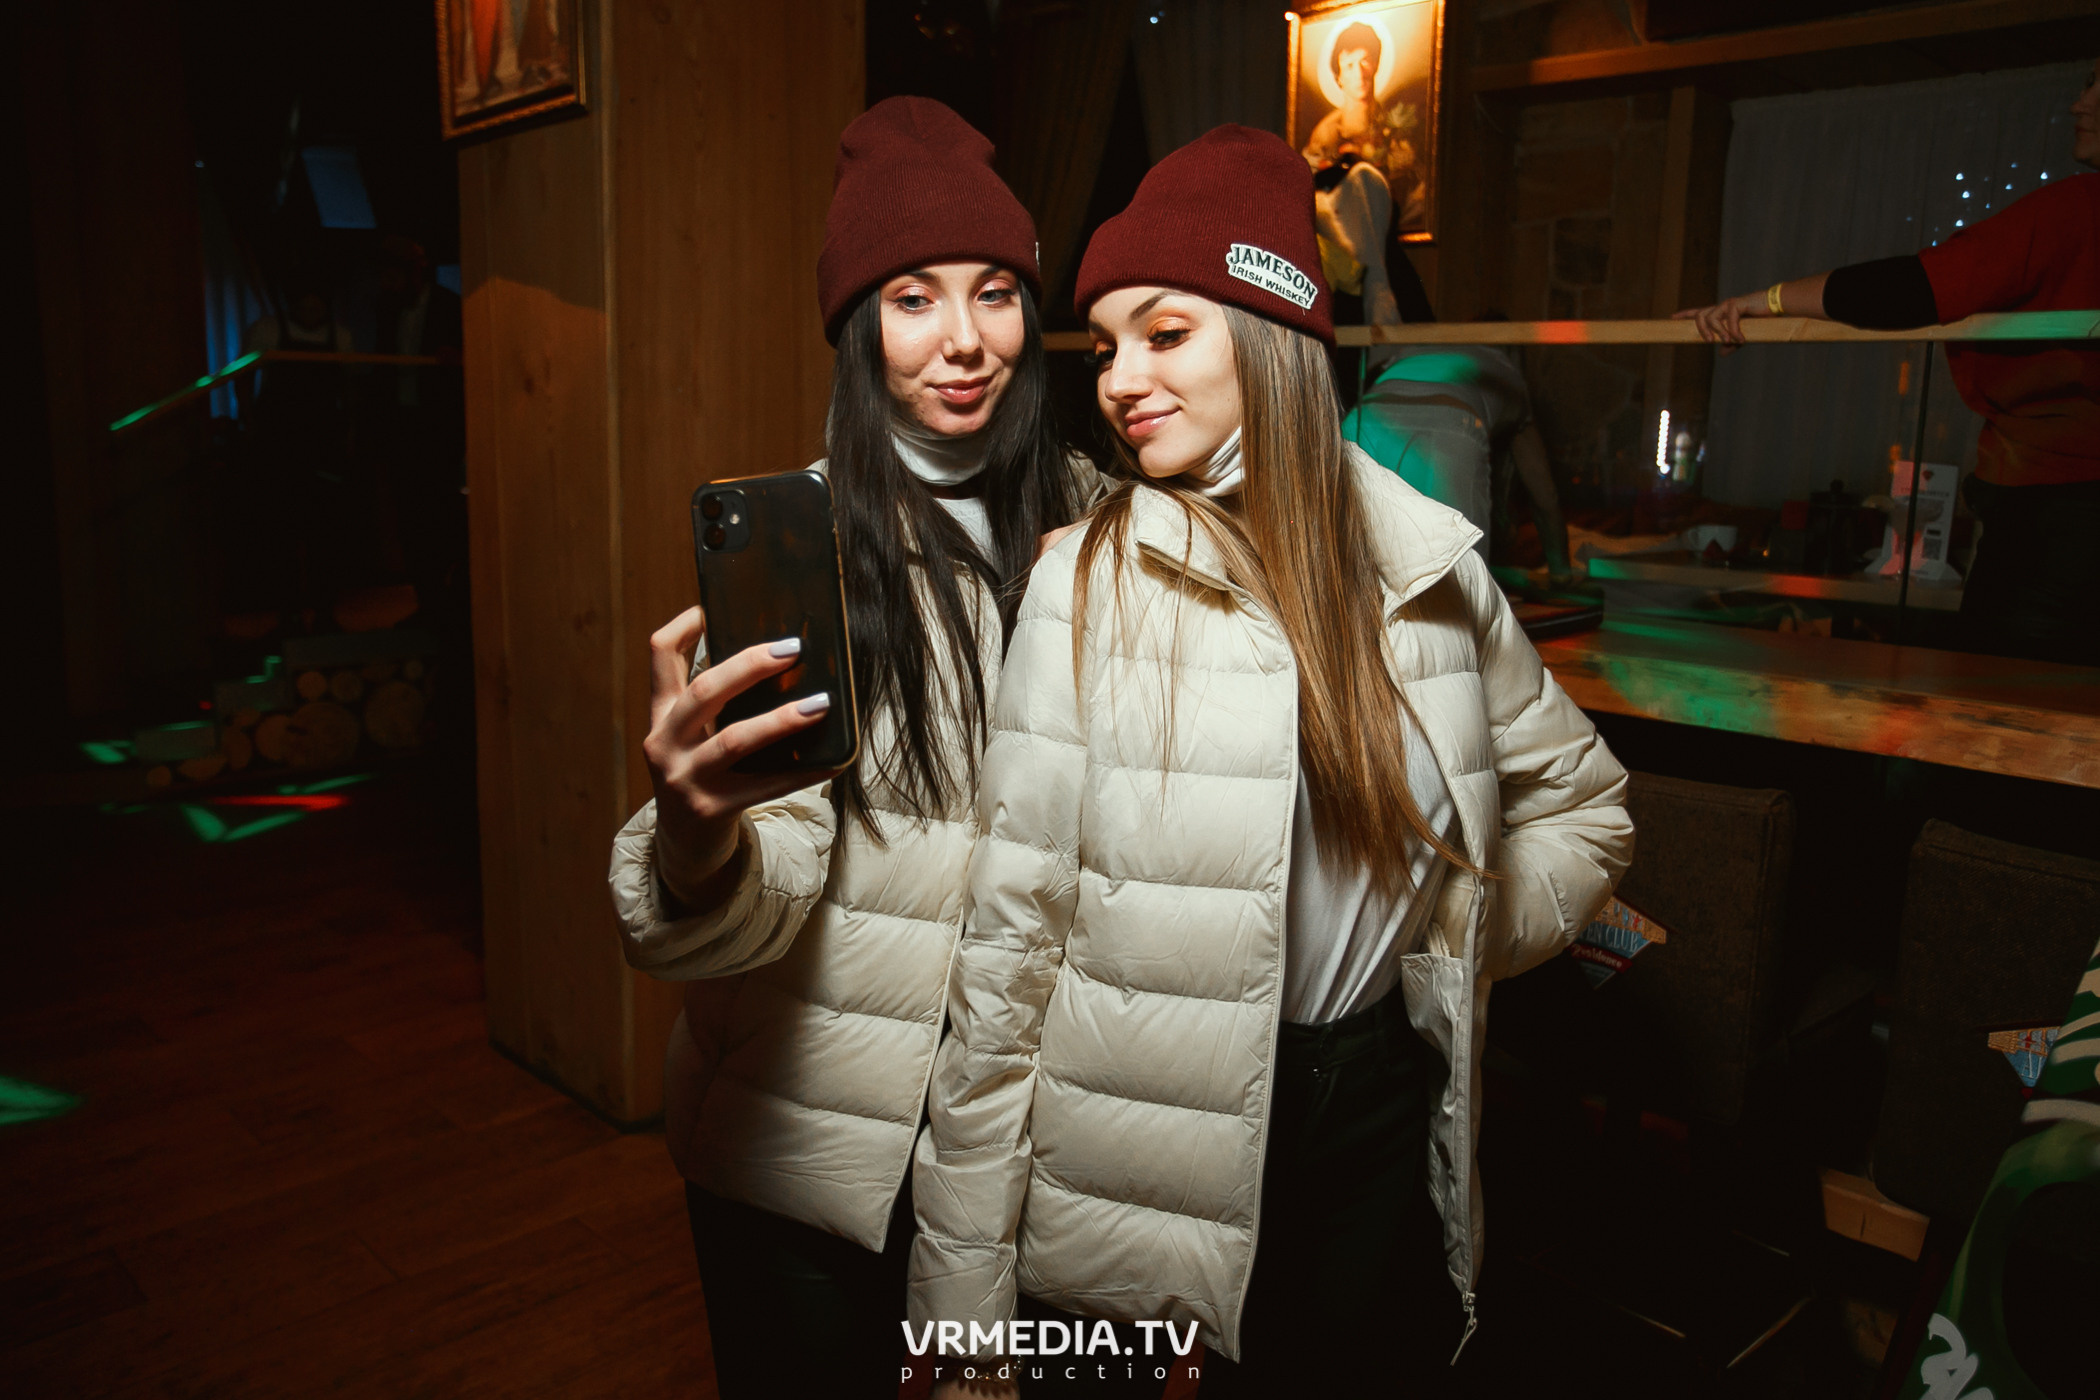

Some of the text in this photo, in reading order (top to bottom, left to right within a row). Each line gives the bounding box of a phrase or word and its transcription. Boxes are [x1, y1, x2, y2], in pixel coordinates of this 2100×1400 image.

[1229, 246, 1316, 300] JAMESON
[1232, 265, 1310, 307] IRISH WHISKEY
[1605, 924, 1639, 953] CLUB
